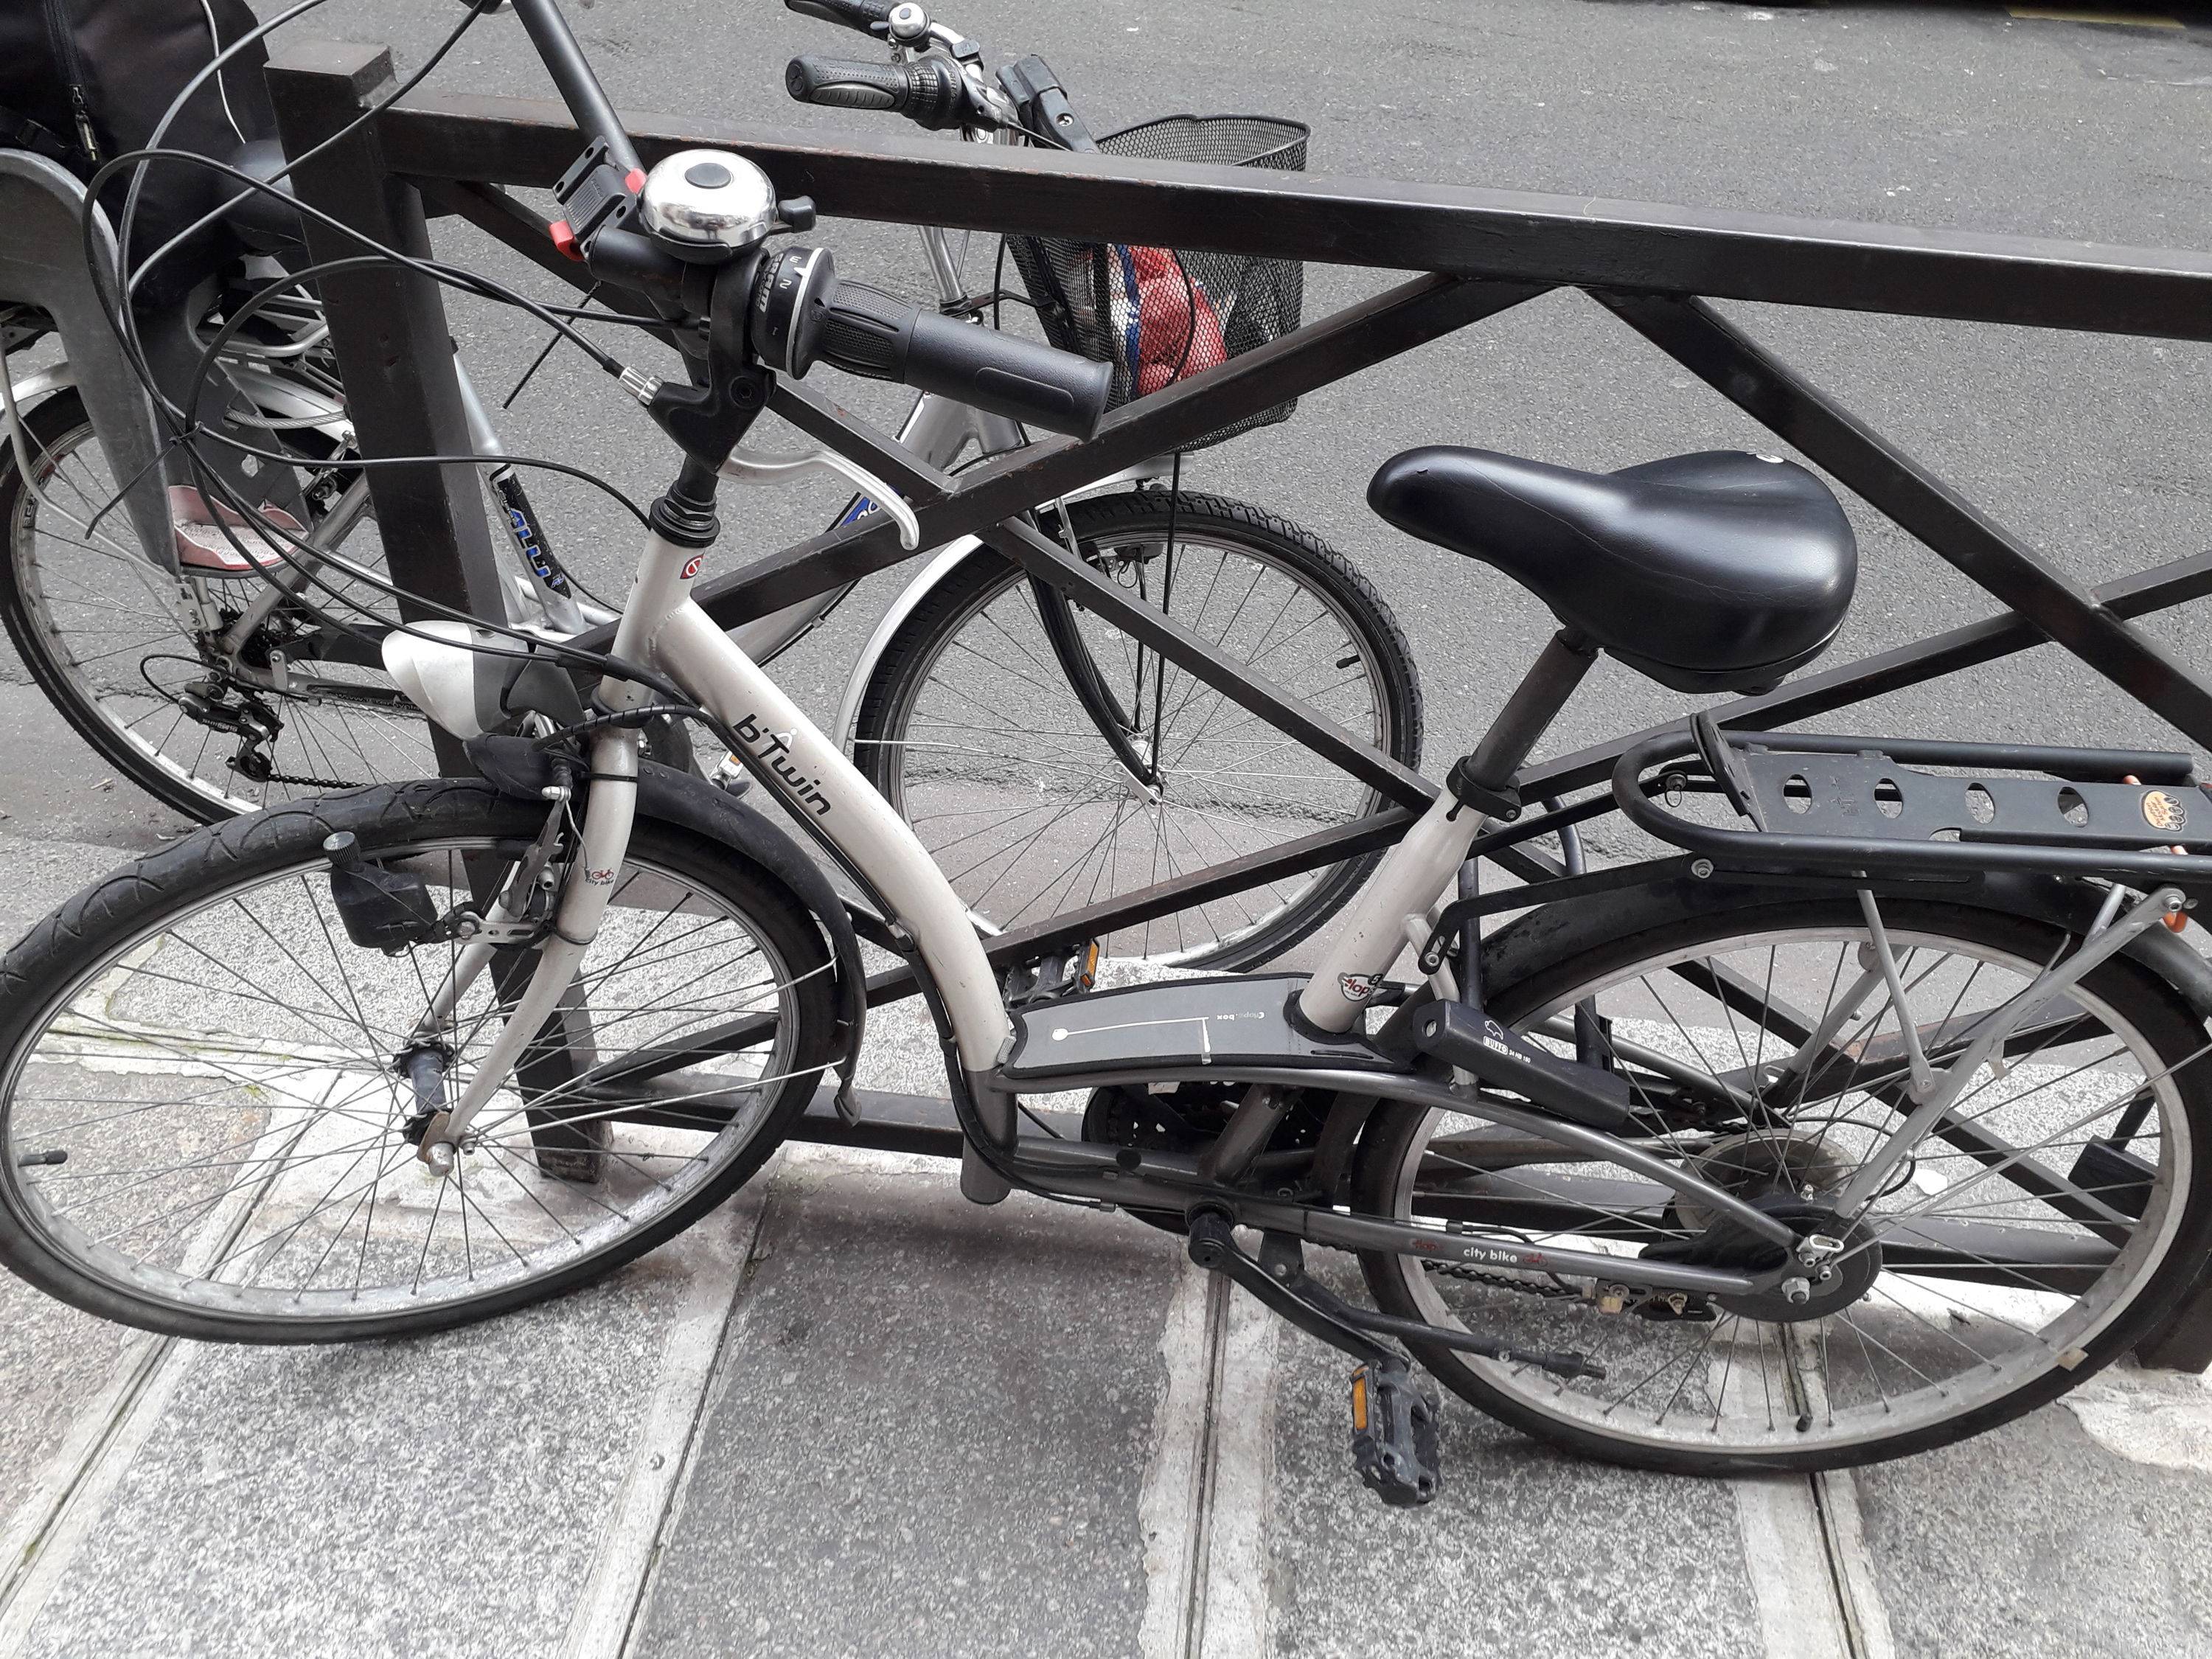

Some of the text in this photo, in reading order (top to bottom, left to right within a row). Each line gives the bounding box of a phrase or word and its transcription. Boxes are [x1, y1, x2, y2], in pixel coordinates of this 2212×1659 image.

[733, 713, 831, 816] b'Twin
[1463, 1246, 1486, 1260] city
[1489, 1249, 1517, 1263] bike
